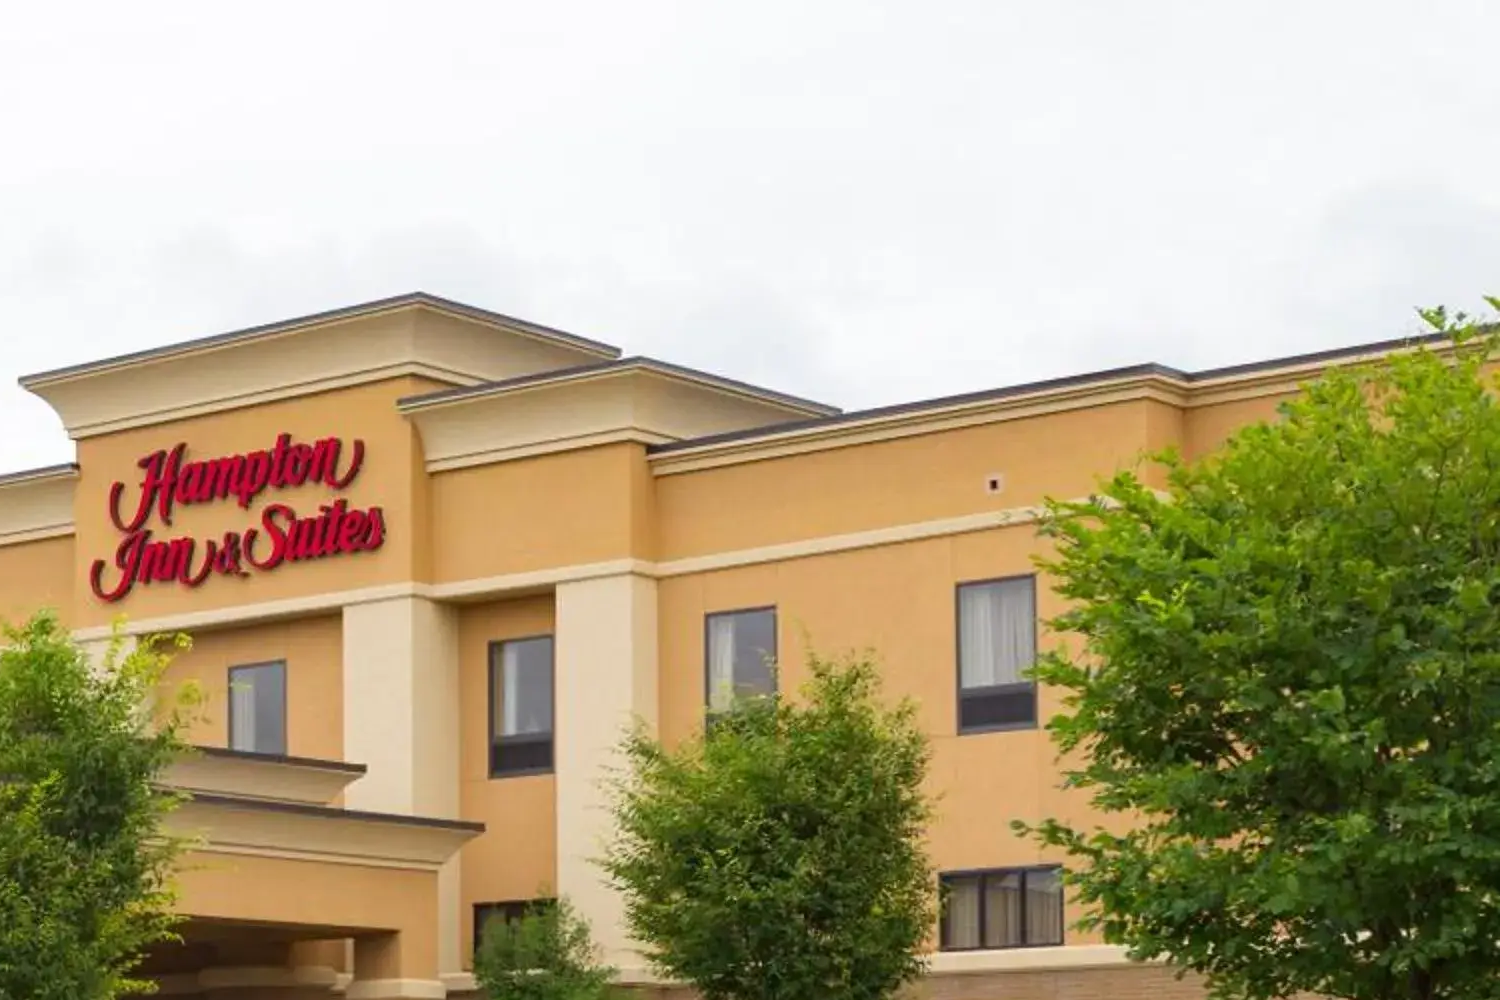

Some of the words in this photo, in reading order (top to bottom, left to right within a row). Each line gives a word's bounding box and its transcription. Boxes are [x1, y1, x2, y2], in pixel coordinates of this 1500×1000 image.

[109, 432, 365, 534] Hampton
[90, 529, 216, 602] Inn
[243, 498, 386, 572] Suites
